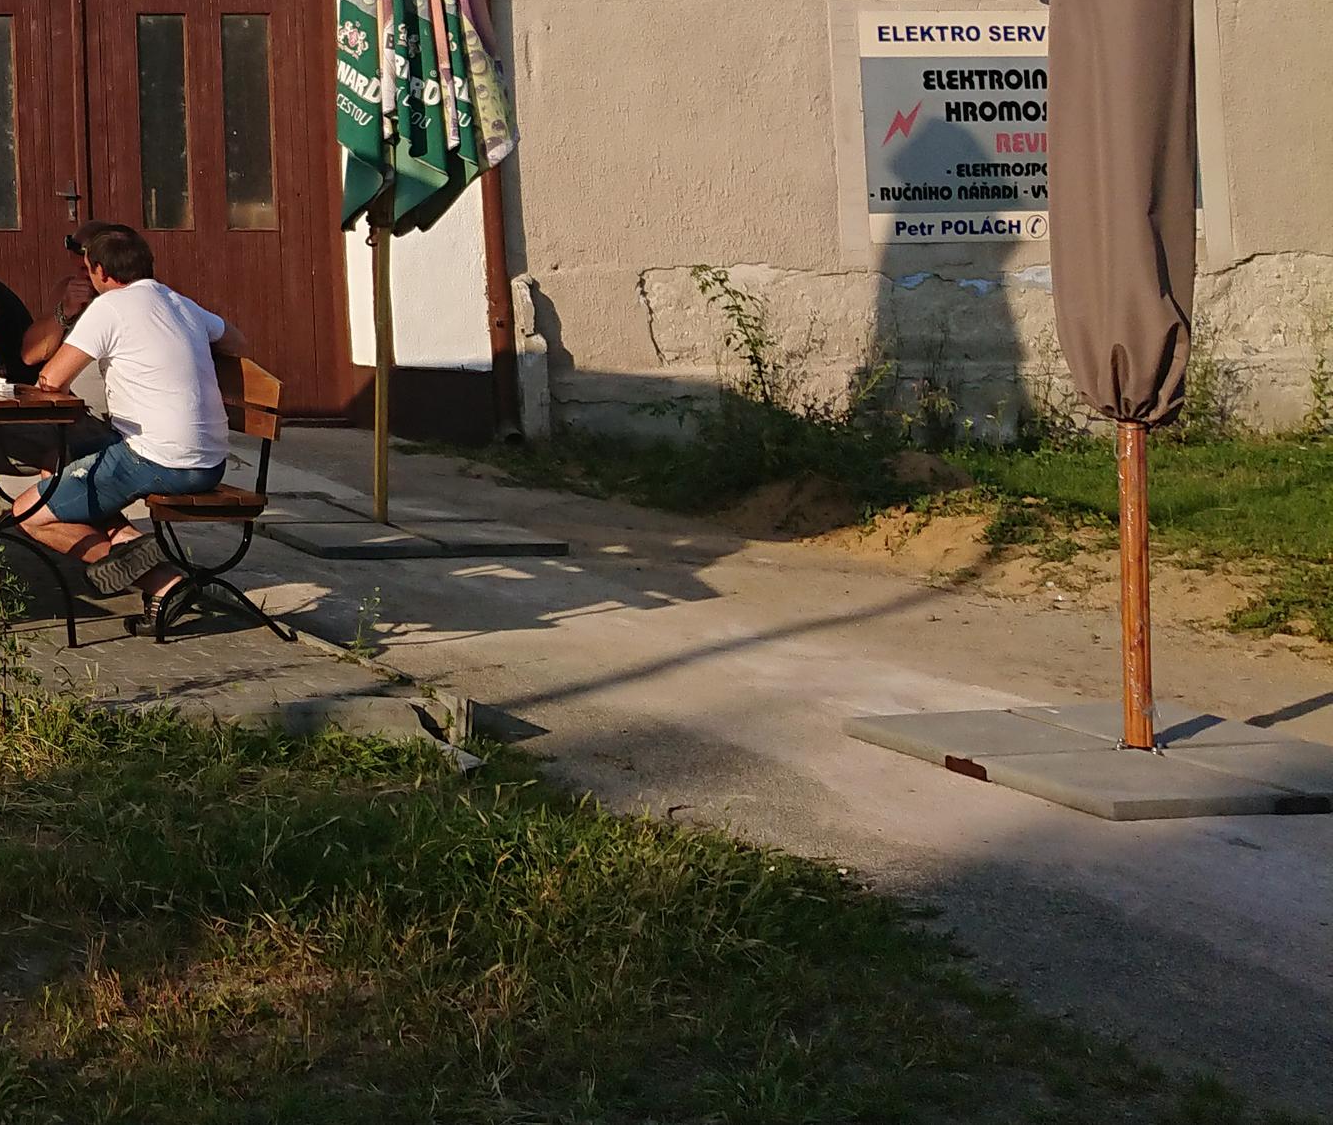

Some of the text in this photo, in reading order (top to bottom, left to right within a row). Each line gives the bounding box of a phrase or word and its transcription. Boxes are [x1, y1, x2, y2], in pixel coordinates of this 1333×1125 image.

[878, 25, 981, 43] ELEKTRO
[880, 182, 952, 201] RUČNÍHO
[957, 181, 1018, 200] NÁŘADÍ
[895, 216, 1021, 236] Petr POLÁCH
